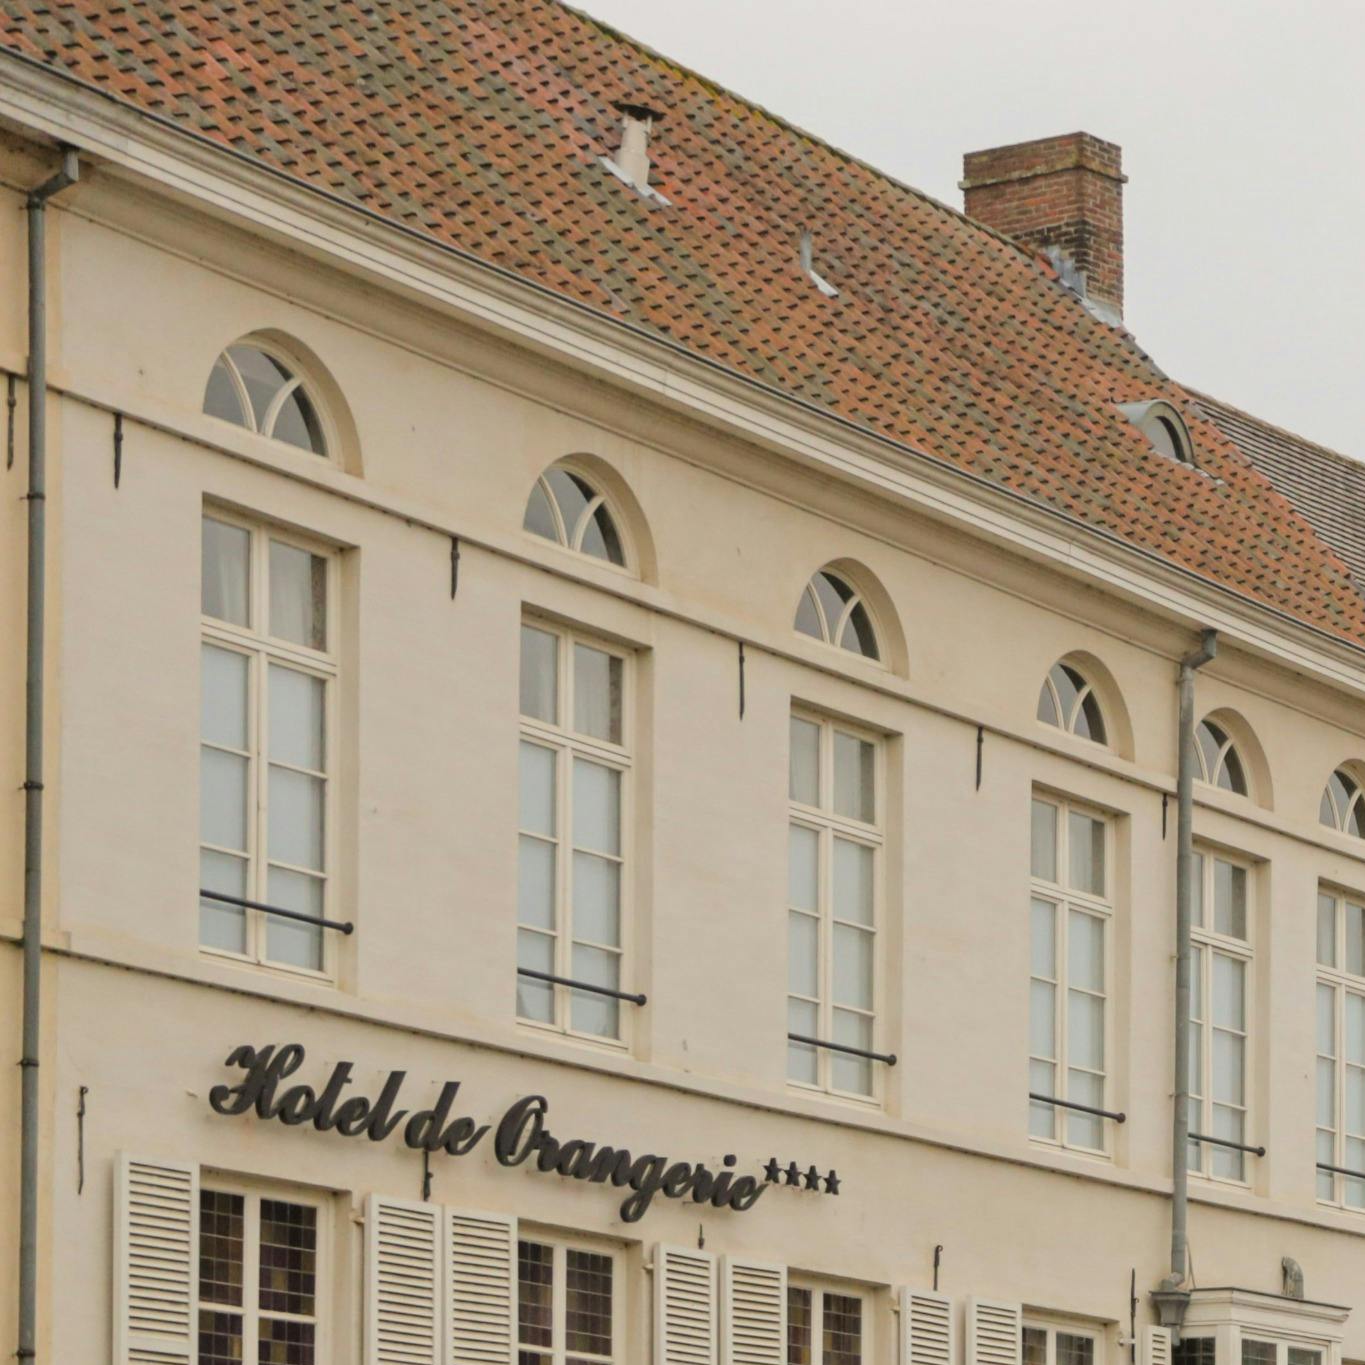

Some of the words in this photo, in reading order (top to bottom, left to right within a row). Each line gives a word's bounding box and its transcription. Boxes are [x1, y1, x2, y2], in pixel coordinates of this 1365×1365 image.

[208, 1043, 409, 1142] Hotel
[404, 1081, 491, 1156] de
[494, 1094, 771, 1224] Orangerie
